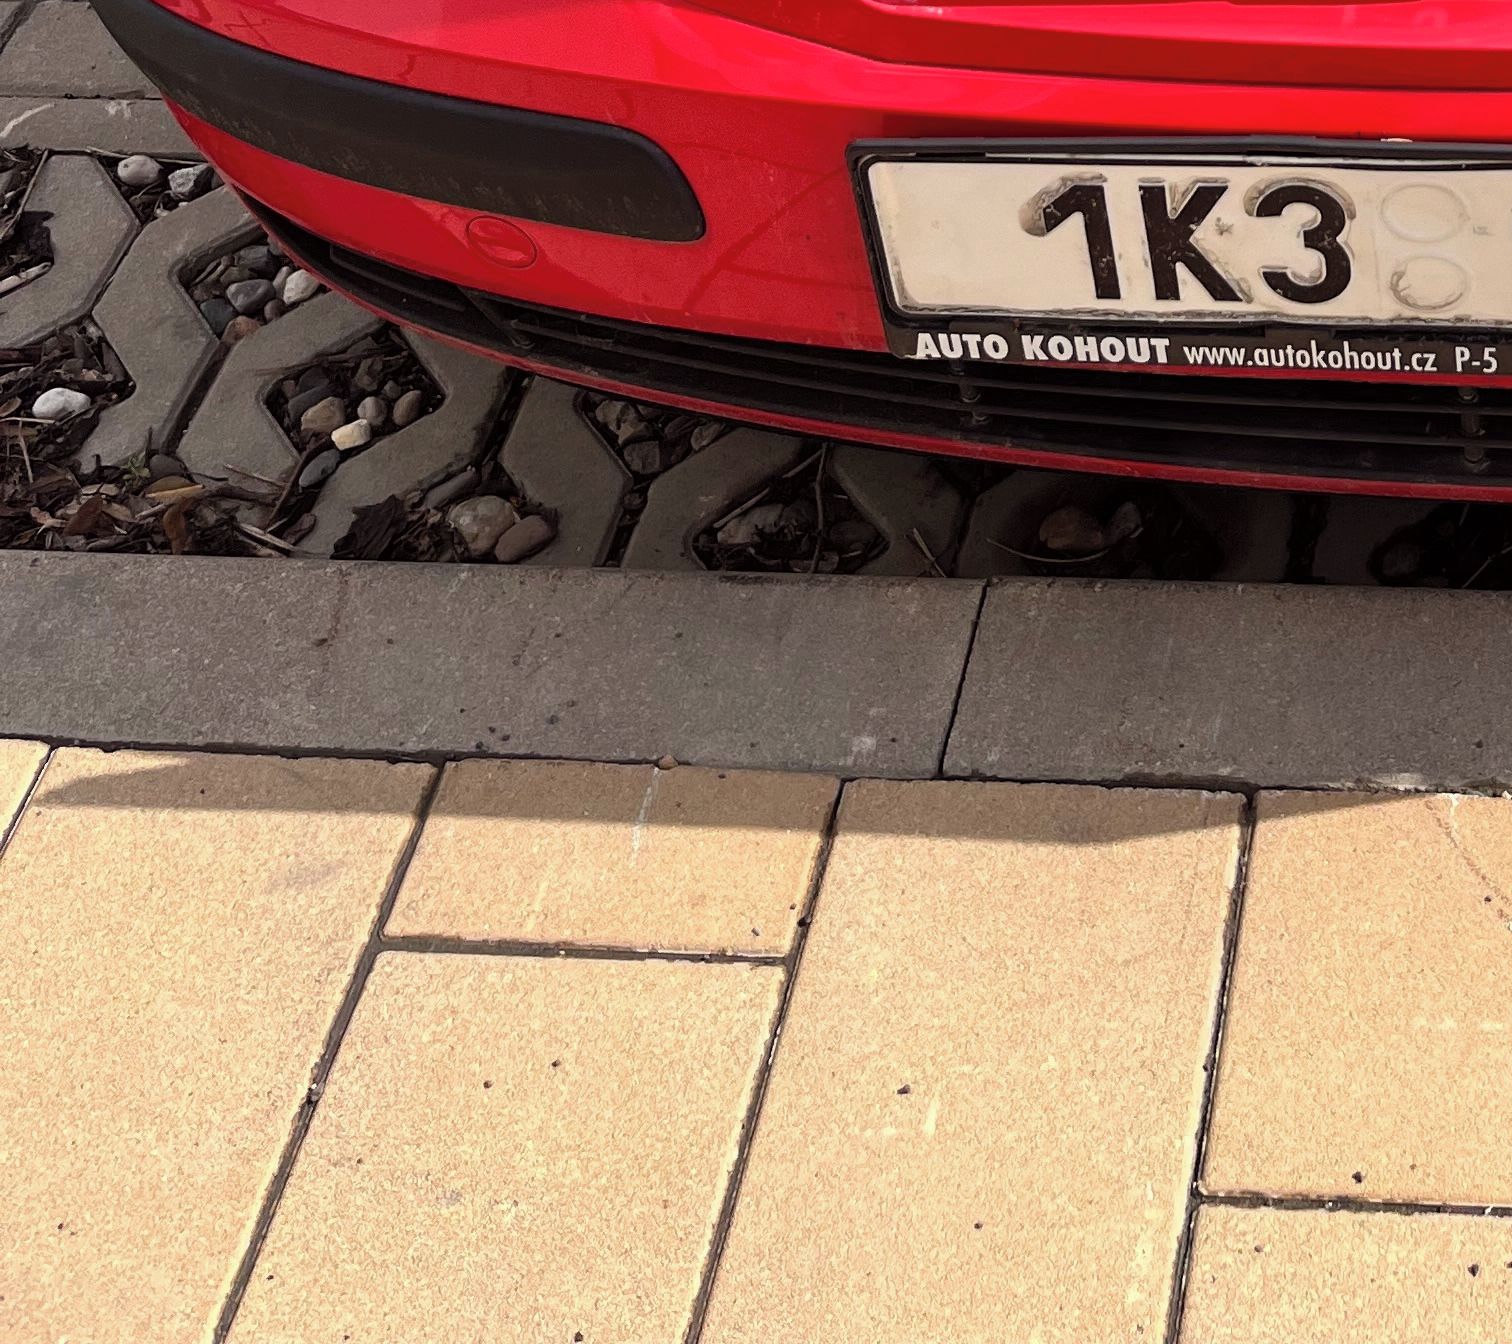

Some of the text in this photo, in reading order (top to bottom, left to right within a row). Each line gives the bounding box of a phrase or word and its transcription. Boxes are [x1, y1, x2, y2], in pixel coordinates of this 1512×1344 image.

[1043, 184, 1352, 303] 1K3
[916, 332, 1009, 361] AUTO
[1022, 335, 1170, 364] KOHOUT
[1182, 340, 1437, 372] www.autokohout.cz
[1455, 346, 1498, 373] P-5
